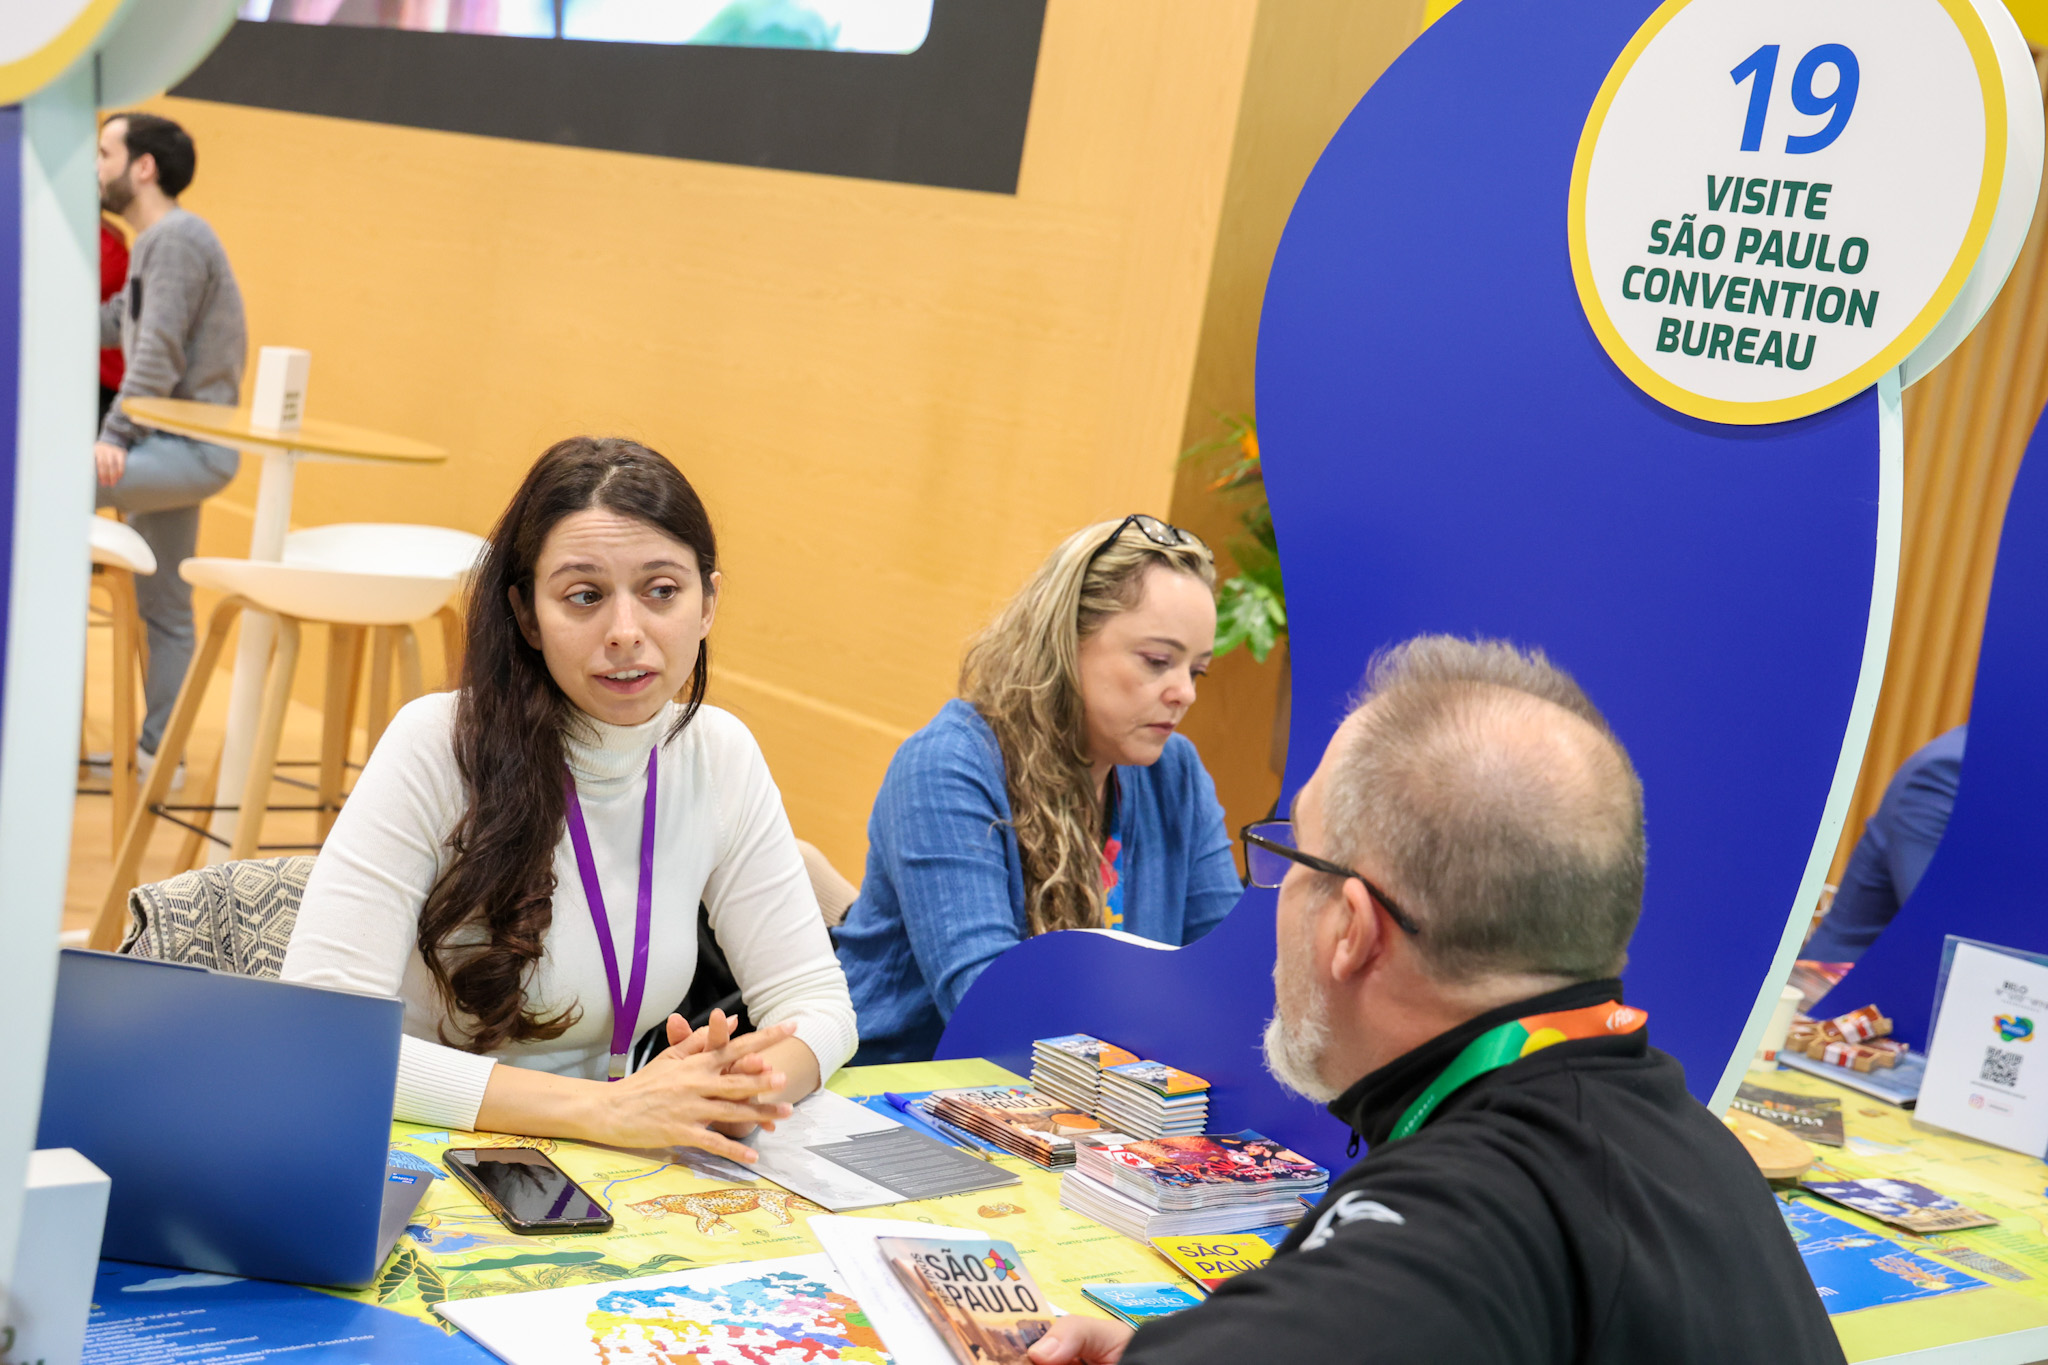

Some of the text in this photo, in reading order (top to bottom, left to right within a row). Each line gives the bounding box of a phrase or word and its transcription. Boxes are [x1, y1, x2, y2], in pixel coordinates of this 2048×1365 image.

[1729, 42, 1860, 155] 19
[1706, 174, 1833, 220] VISITE
[1647, 213, 1869, 275] SÃO PAULO
[1621, 265, 1880, 328] CONVENTION
[1655, 316, 1817, 371] BUREAU
[967, 1089, 1012, 1101] SÃO
[984, 1097, 1052, 1109] PAULO
[639, 1229, 668, 1237] VELHO
[763, 1235, 804, 1244] FLORESTA
[1057, 1238, 1081, 1246] PORTO
[1082, 1235, 1112, 1243] SEGURO
[1177, 1242, 1239, 1258] SÃO
[925, 1248, 988, 1282] SÃO
[1079, 1271, 1123, 1280] HORIZONTE
[943, 1285, 1039, 1313] PAULO
